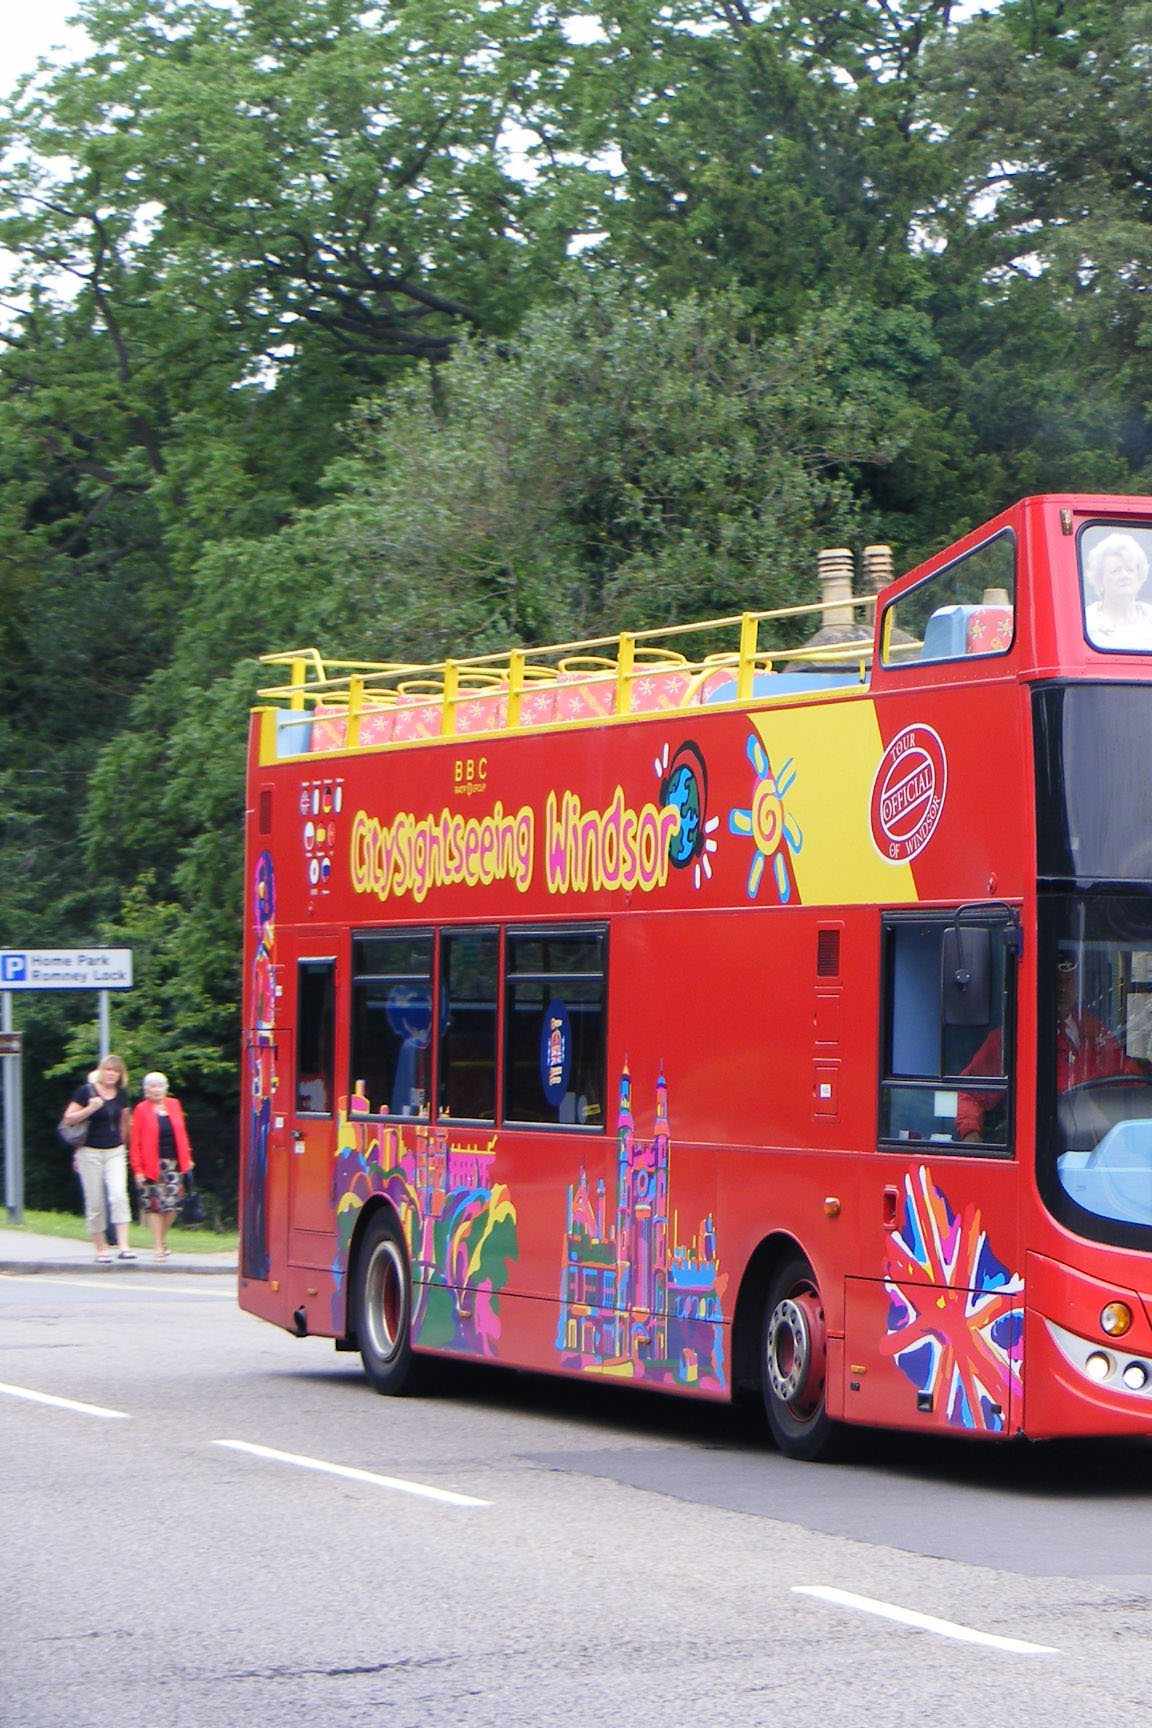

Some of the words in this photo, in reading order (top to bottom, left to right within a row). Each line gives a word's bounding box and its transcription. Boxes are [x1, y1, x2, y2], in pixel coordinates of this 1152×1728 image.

[889, 732, 916, 762] TOUR
[882, 768, 933, 821] OFFICIAL
[351, 800, 535, 903] CitySightseeing
[546, 784, 681, 894] Windsor
[888, 842, 901, 859] OF
[904, 794, 941, 856] WINDSOR
[32, 955, 72, 967] Home
[78, 954, 110, 966] Park
[32, 970, 88, 983] Romney
[94, 970, 127, 981] Lock
